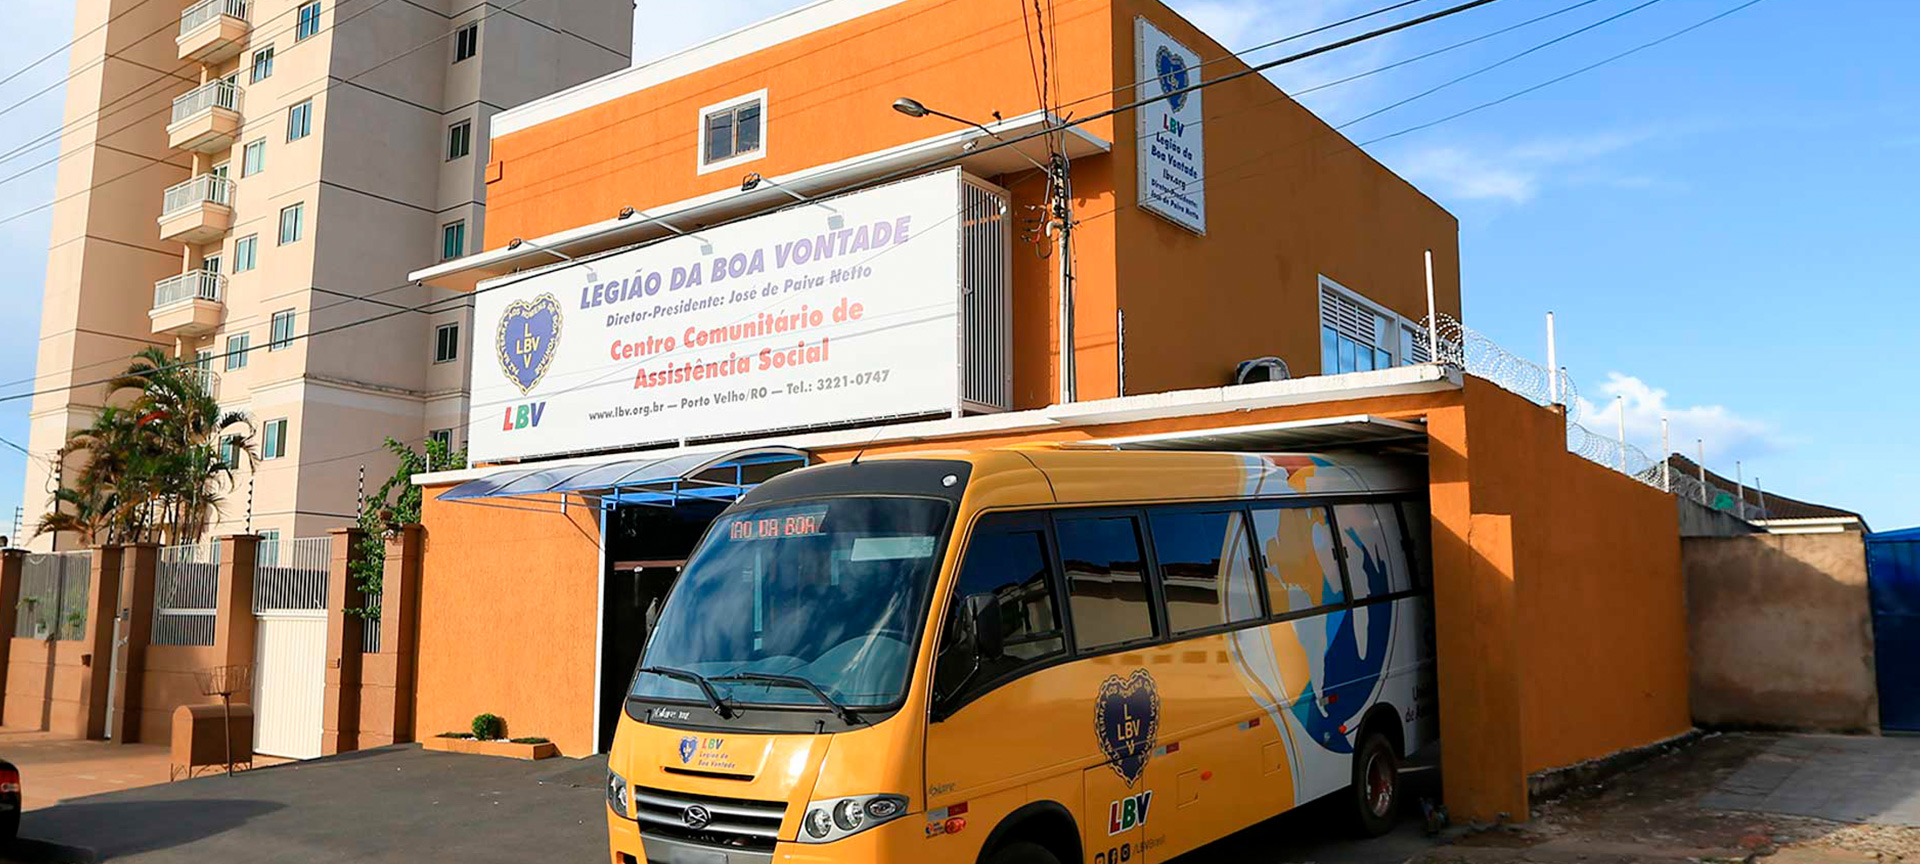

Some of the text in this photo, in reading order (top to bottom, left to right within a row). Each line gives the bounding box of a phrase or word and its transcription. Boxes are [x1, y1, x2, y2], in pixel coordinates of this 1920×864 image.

[1163, 113, 1184, 138] LBV
[1156, 131, 1192, 160] Legião da
[1151, 144, 1198, 179] Boa Vontade
[1163, 168, 1186, 191] lbv.org
[579, 215, 912, 310] LEGIÃO DA BOA VONTADE
[606, 265, 872, 328] Diretor-Presidente: José de Paiva Netto
[524, 323, 532, 337] L
[610, 297, 864, 361] Centro Comunitário de
[516, 336, 540, 355] LBV
[523, 353, 532, 369] V
[634, 337, 829, 390] Assistência Social
[588, 401, 665, 421] www.lbv.org.br
[680, 396, 710, 409] Porto
[713, 386, 767, 405] Velho/RO
[787, 380, 812, 395] Tel.:
[816, 369, 890, 392] 3221-0747
[503, 401, 546, 431] LBV
[758, 518, 778, 537] DA
[784, 516, 815, 536] BOA
[1123, 703, 1132, 720] L
[1117, 719, 1141, 741] LBV
[701, 738, 724, 750] LBV
[1126, 739, 1135, 755] V
[1108, 790, 1152, 836] LBV
